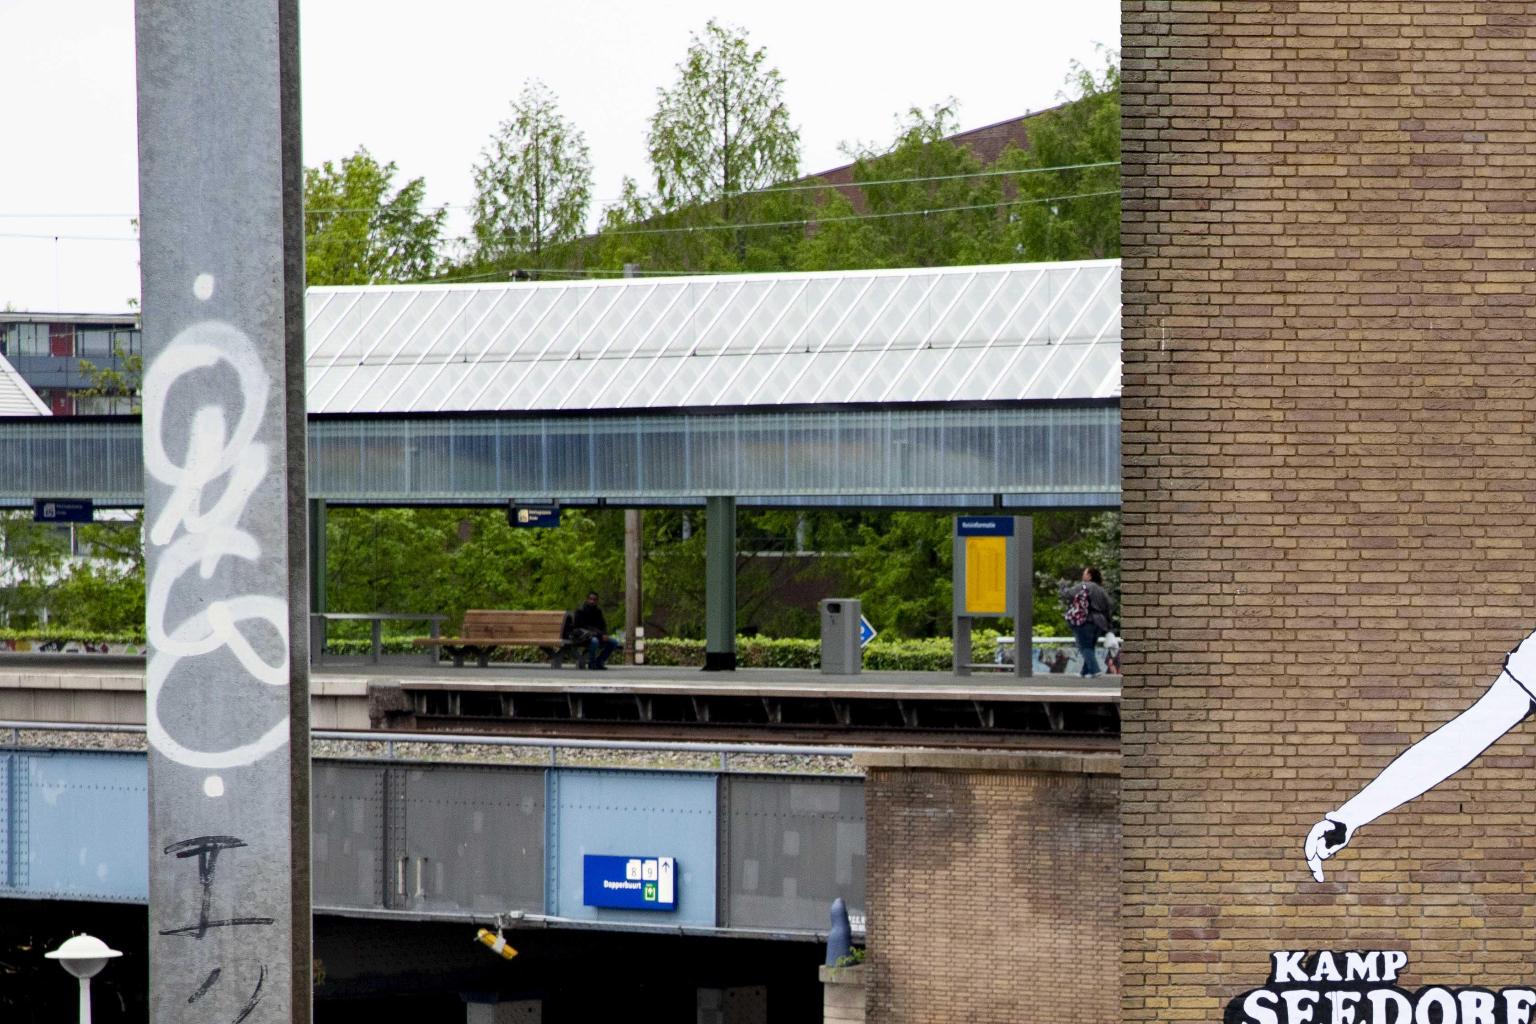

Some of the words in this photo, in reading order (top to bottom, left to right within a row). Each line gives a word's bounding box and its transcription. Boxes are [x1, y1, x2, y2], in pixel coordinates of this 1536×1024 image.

[631, 867, 637, 877] 8
[647, 868, 653, 878] 9
[603, 880, 642, 890] Dapperbuurt
[1273, 950, 1409, 984] KAMP
